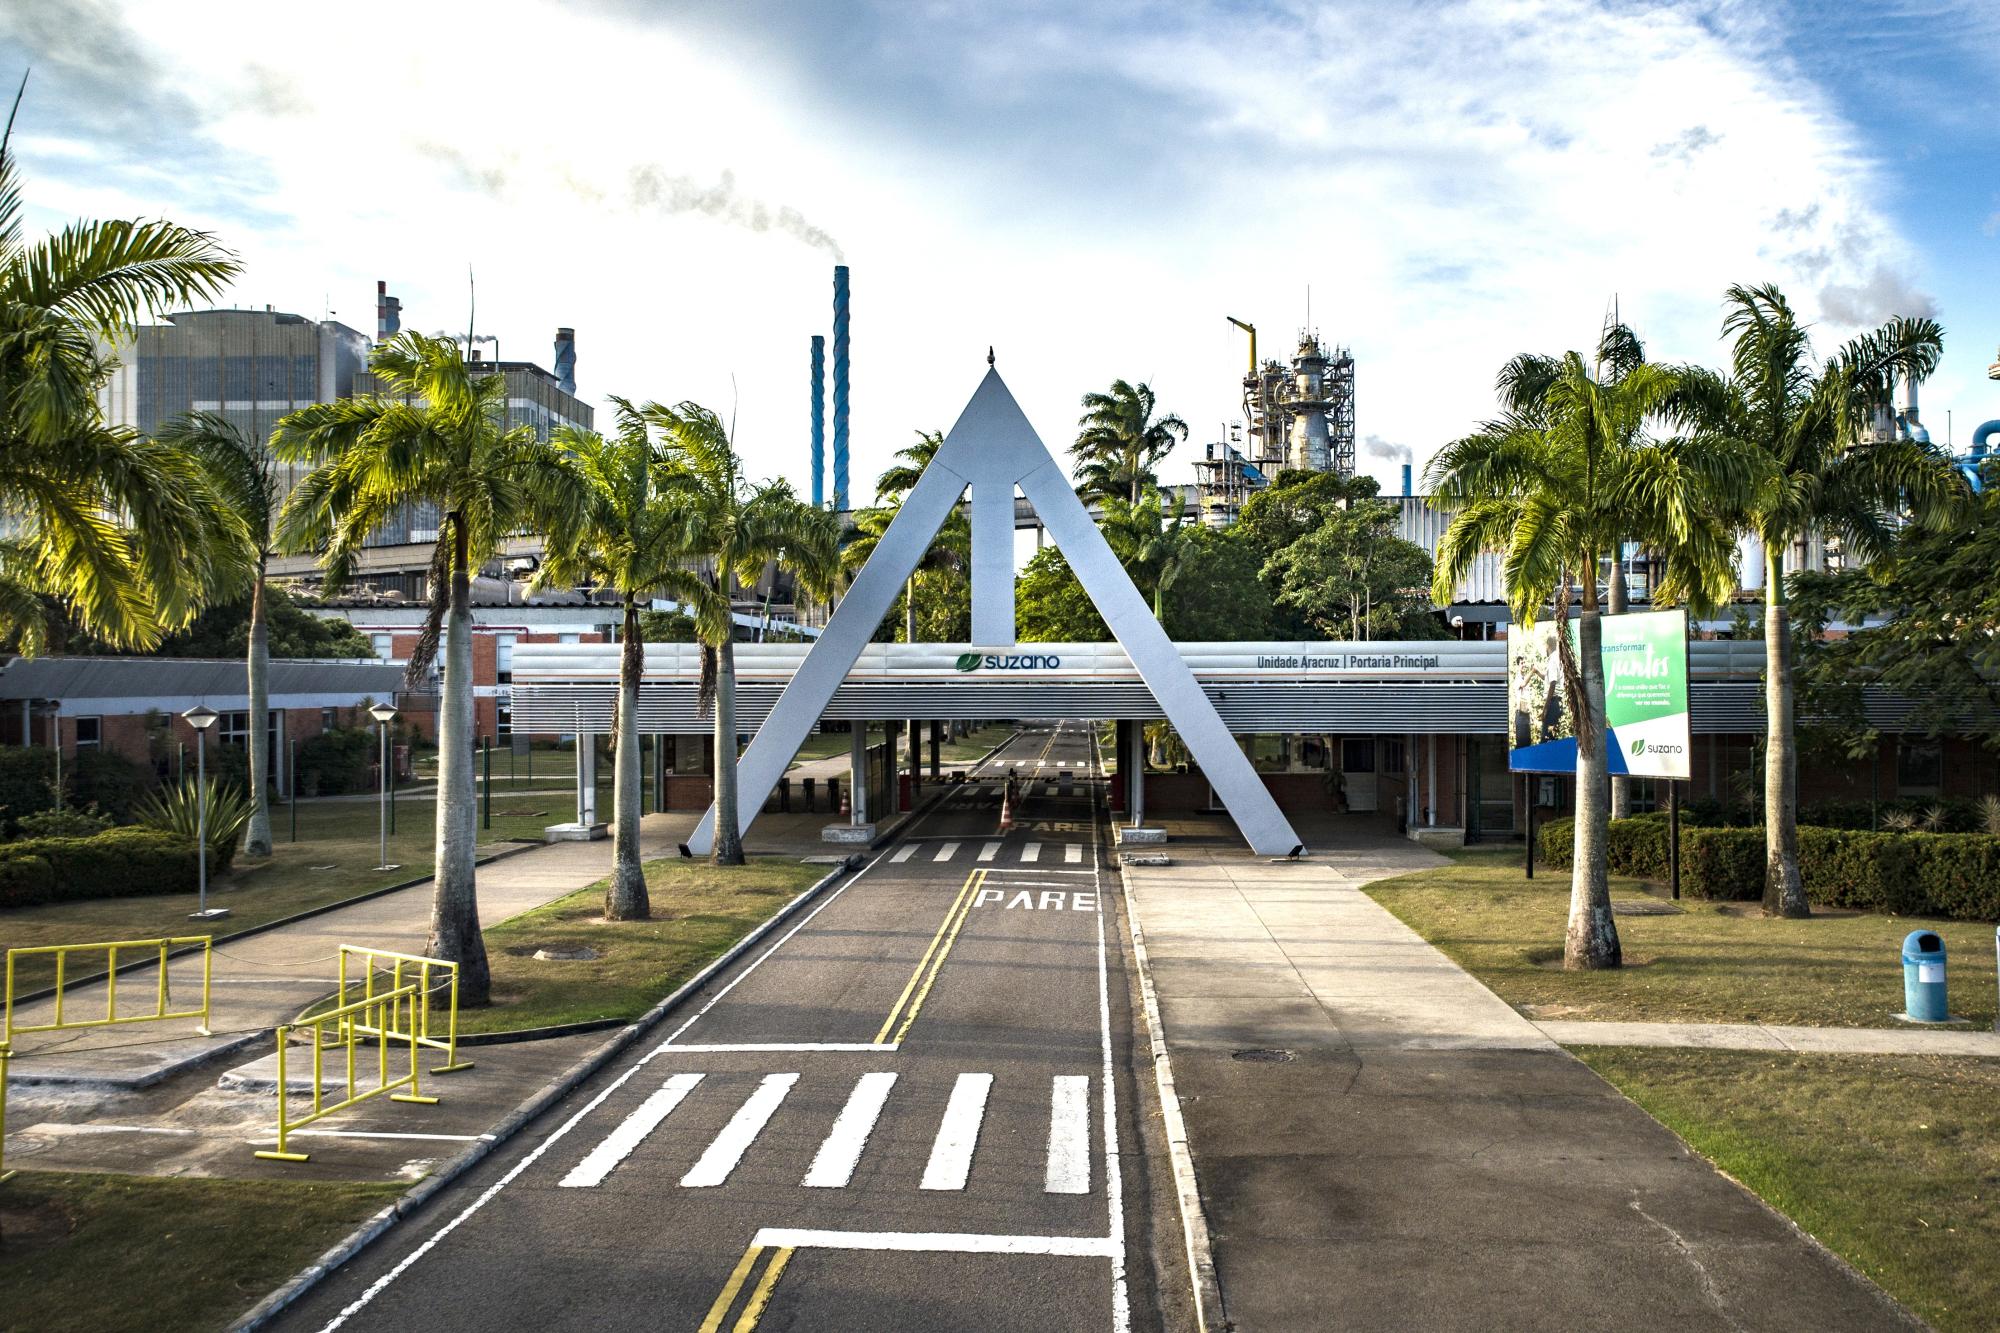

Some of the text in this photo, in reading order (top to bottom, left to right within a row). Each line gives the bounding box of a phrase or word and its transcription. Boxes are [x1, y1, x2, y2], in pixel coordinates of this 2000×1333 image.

[1601, 643, 1646, 653] transformar
[985, 655, 1060, 669] suzano
[1257, 655, 1298, 669] Unidade
[1300, 655, 1340, 669] Aracruz
[1350, 655, 1391, 669] Portaria
[1393, 655, 1439, 671] Principal
[1605, 643, 1670, 697] juntos
[1647, 744, 1683, 754] suzano
[1009, 822, 1095, 833] PARE
[972, 889, 1096, 912] PARE
